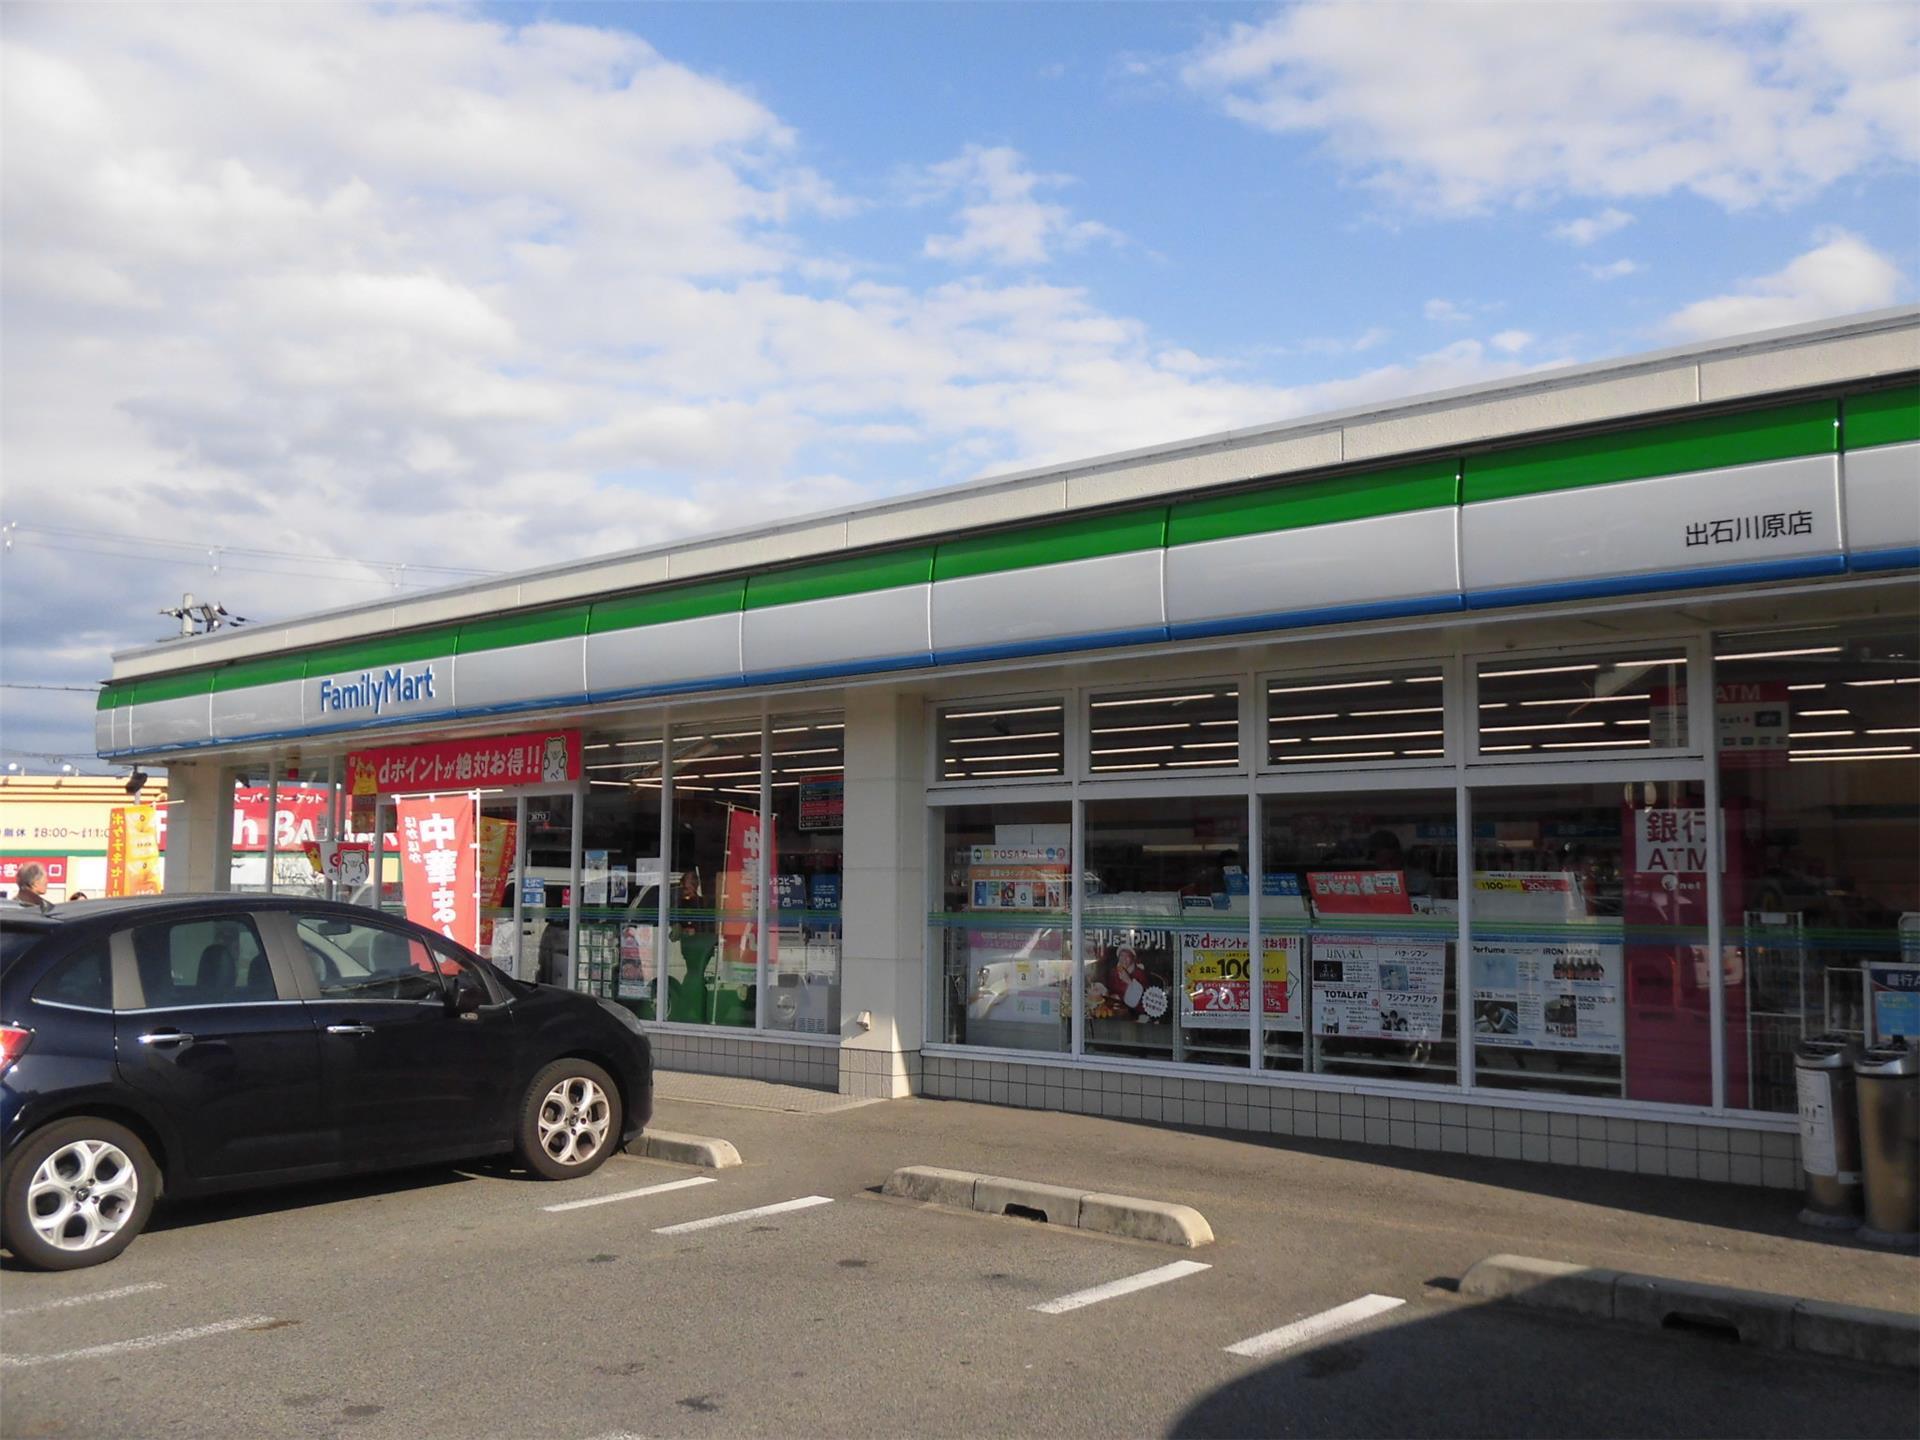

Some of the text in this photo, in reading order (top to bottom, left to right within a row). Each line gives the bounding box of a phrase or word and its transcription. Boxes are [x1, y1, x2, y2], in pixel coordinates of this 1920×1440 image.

[1686, 510, 1812, 547] 出石川原店
[321, 666, 435, 714] FamilyMart
[1647, 848, 1706, 870] ATM
[1324, 990, 1368, 999] TOTALFAT
[1386, 994, 1438, 1003] フジファブリック
